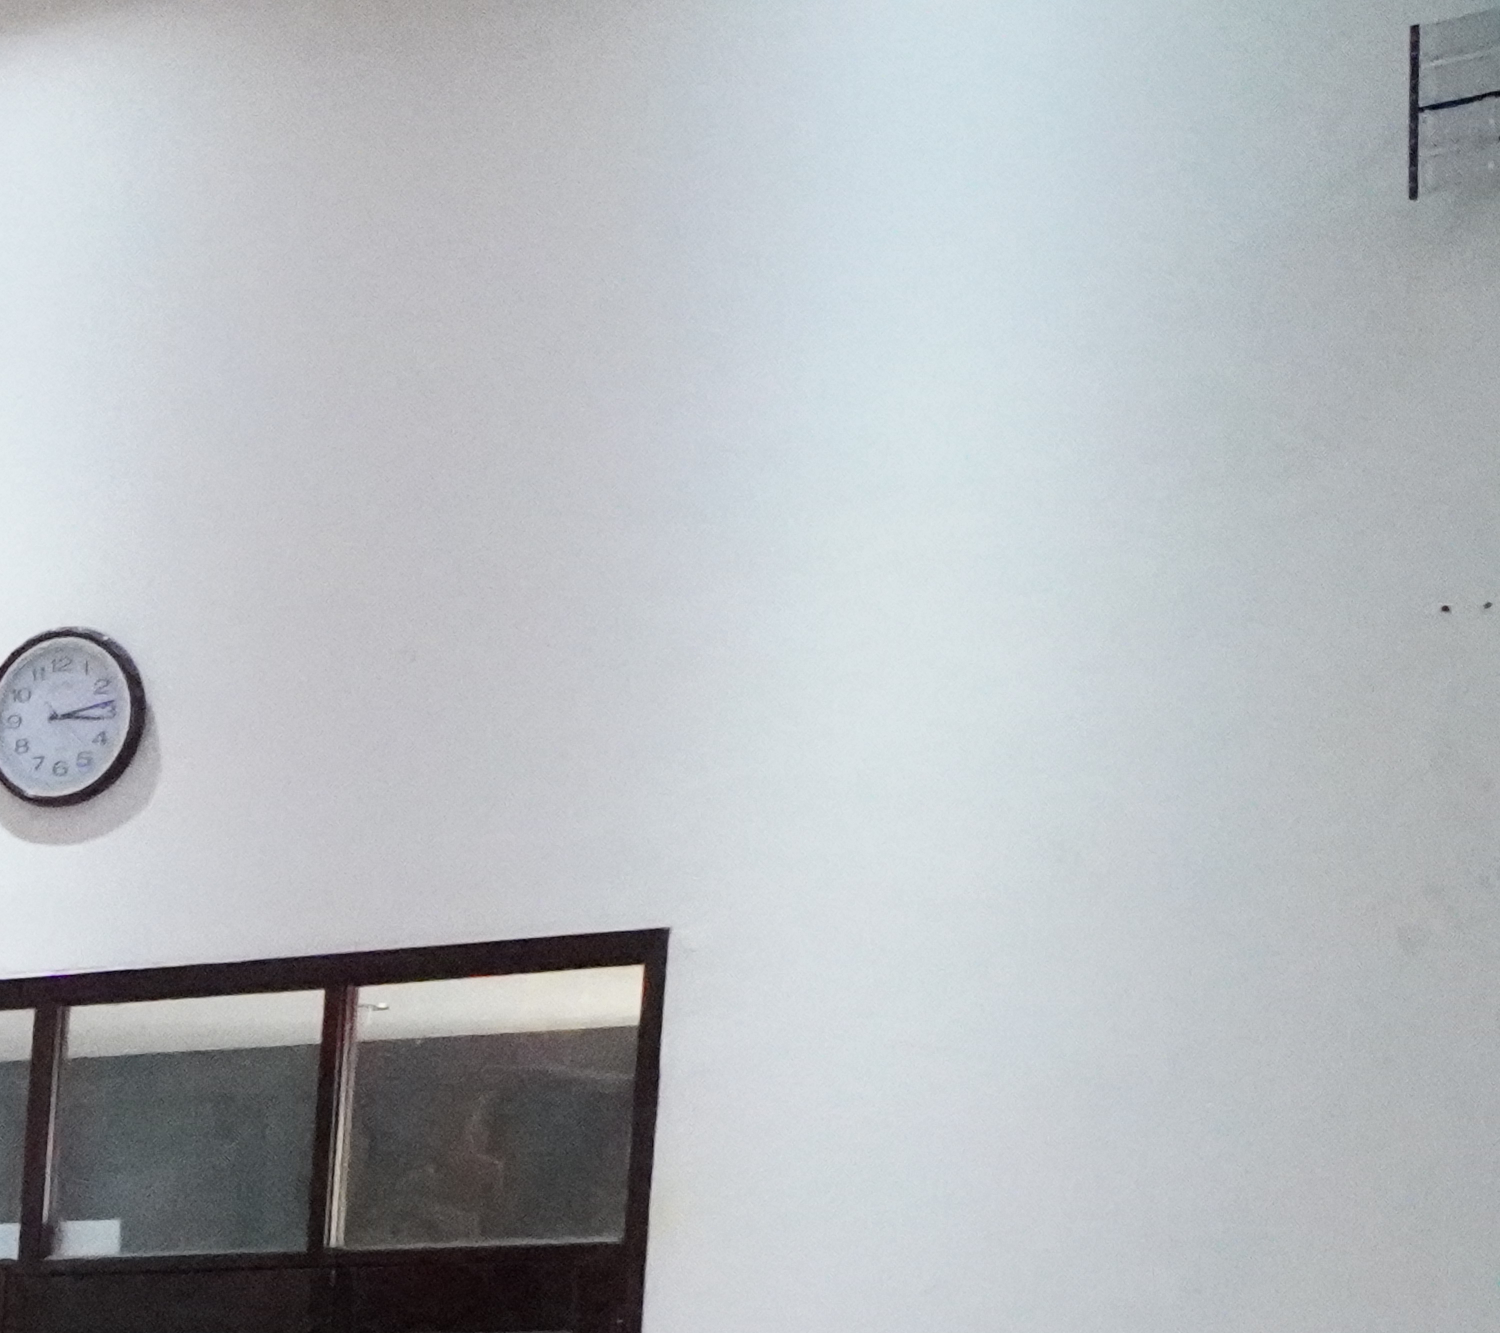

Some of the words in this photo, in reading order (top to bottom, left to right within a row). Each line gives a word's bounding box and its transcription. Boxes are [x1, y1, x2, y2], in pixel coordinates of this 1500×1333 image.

[51, 656, 73, 673] 12
[94, 679, 110, 695] 2
[11, 688, 32, 703] 10
[7, 714, 23, 729] 9
[14, 738, 29, 754] 8
[92, 731, 108, 746] 4
[33, 756, 45, 771] 7
[76, 751, 94, 770] 5
[52, 761, 69, 777] 6
